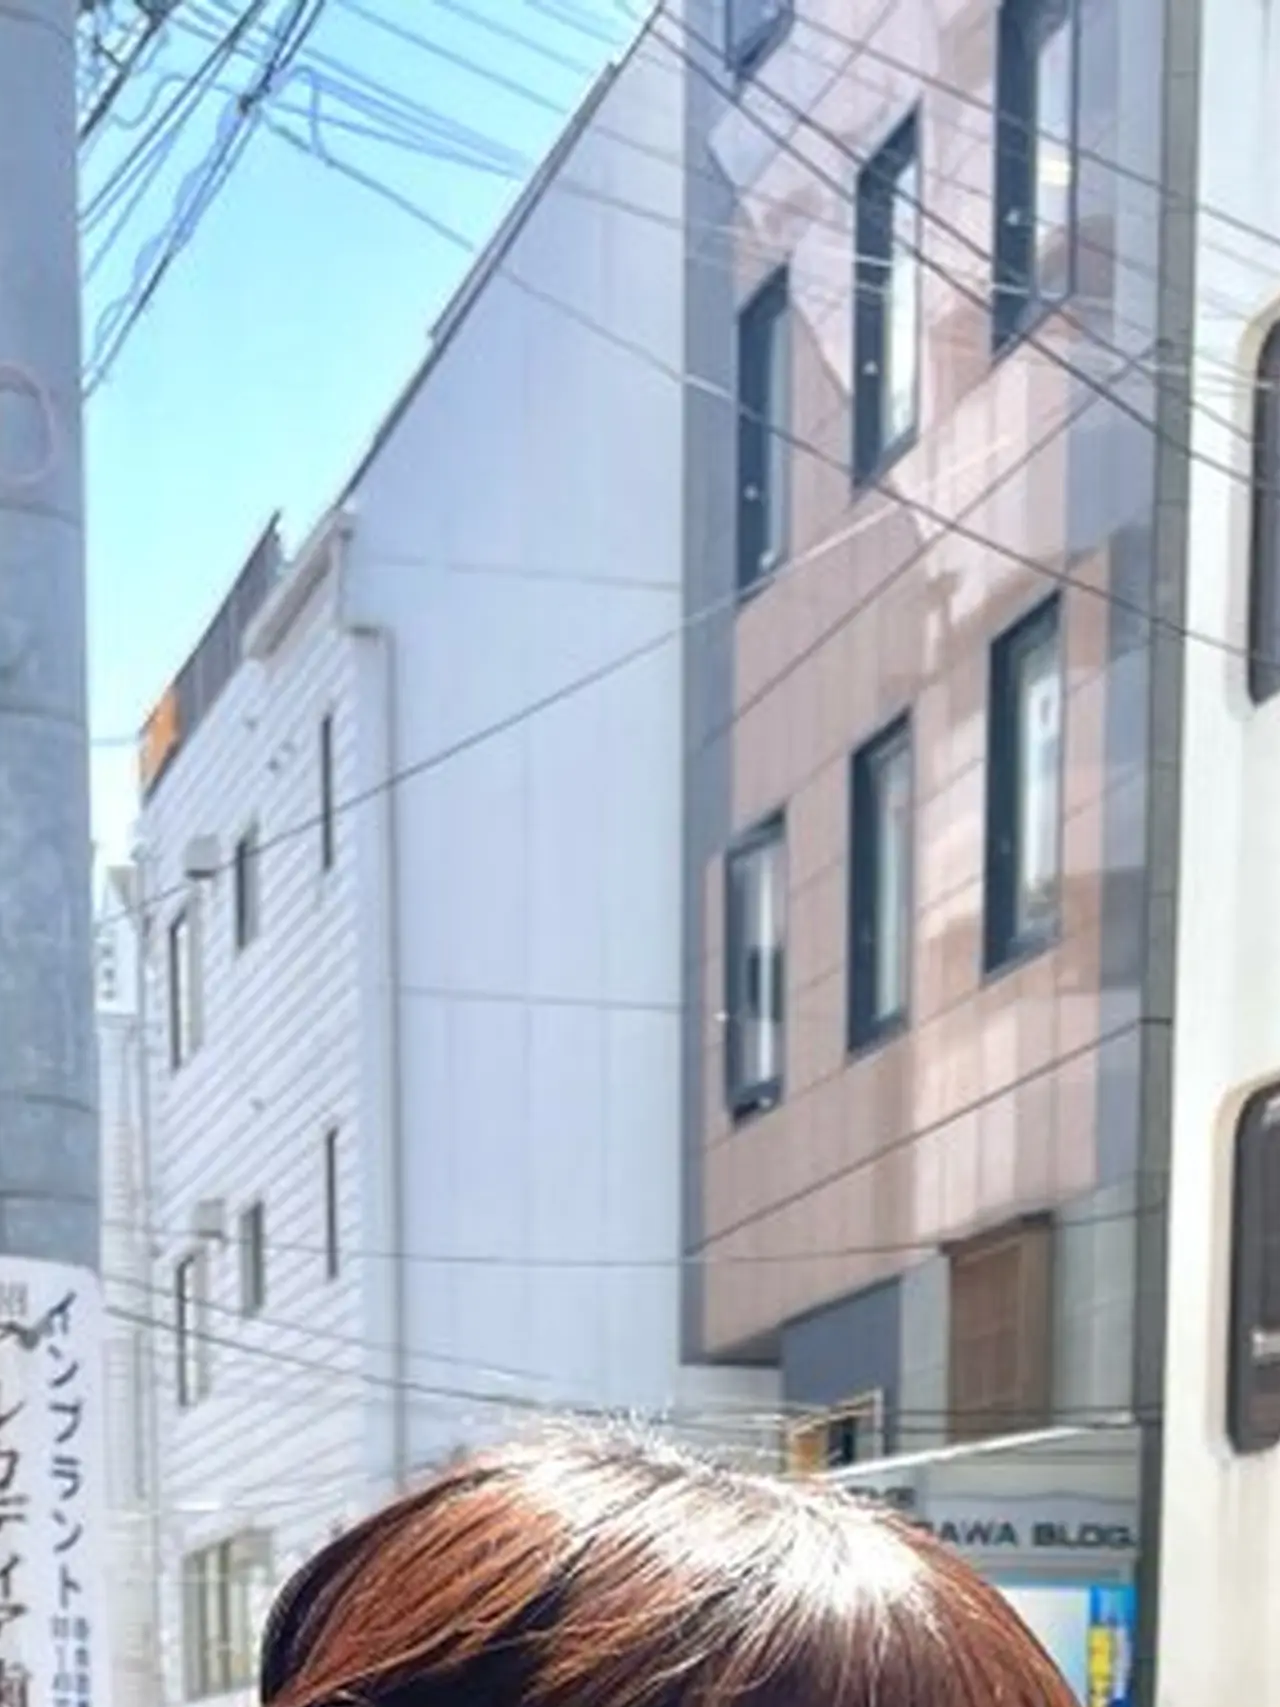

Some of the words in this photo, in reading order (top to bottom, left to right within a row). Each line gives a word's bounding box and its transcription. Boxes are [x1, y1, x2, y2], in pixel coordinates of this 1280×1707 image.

[47, 1291, 84, 1609] インプラント
